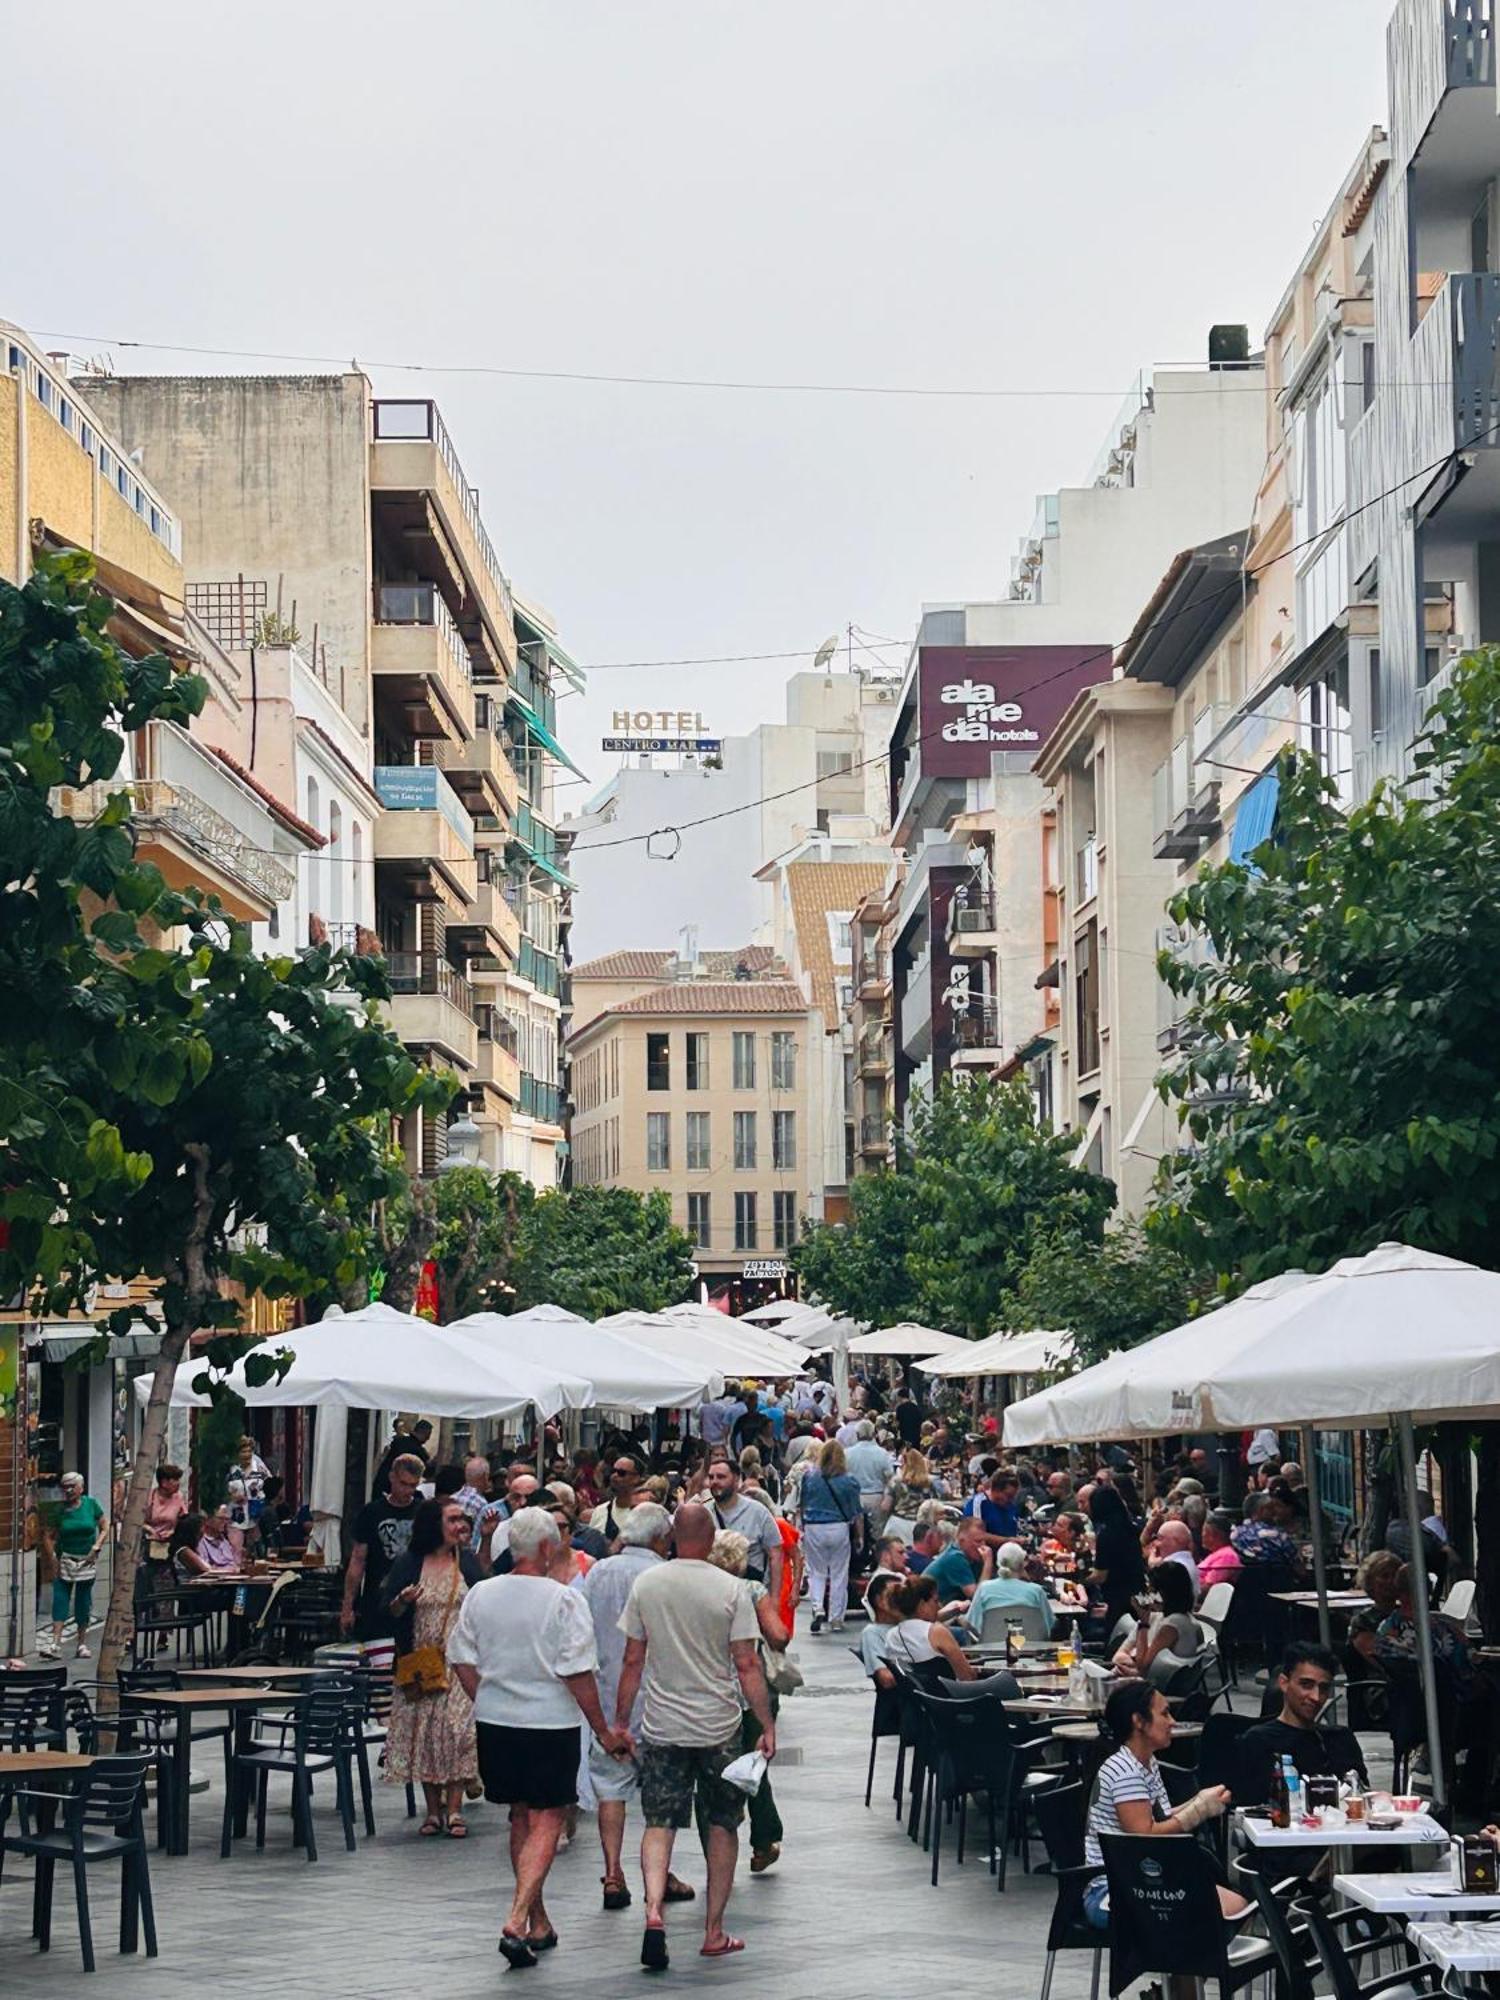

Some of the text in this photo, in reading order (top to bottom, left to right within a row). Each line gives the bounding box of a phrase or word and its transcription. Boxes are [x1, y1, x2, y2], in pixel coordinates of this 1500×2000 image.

[612, 711, 710, 731] HOTEL
[990, 729, 1039, 741] hotels
[604, 740, 661, 751] CENTRO
